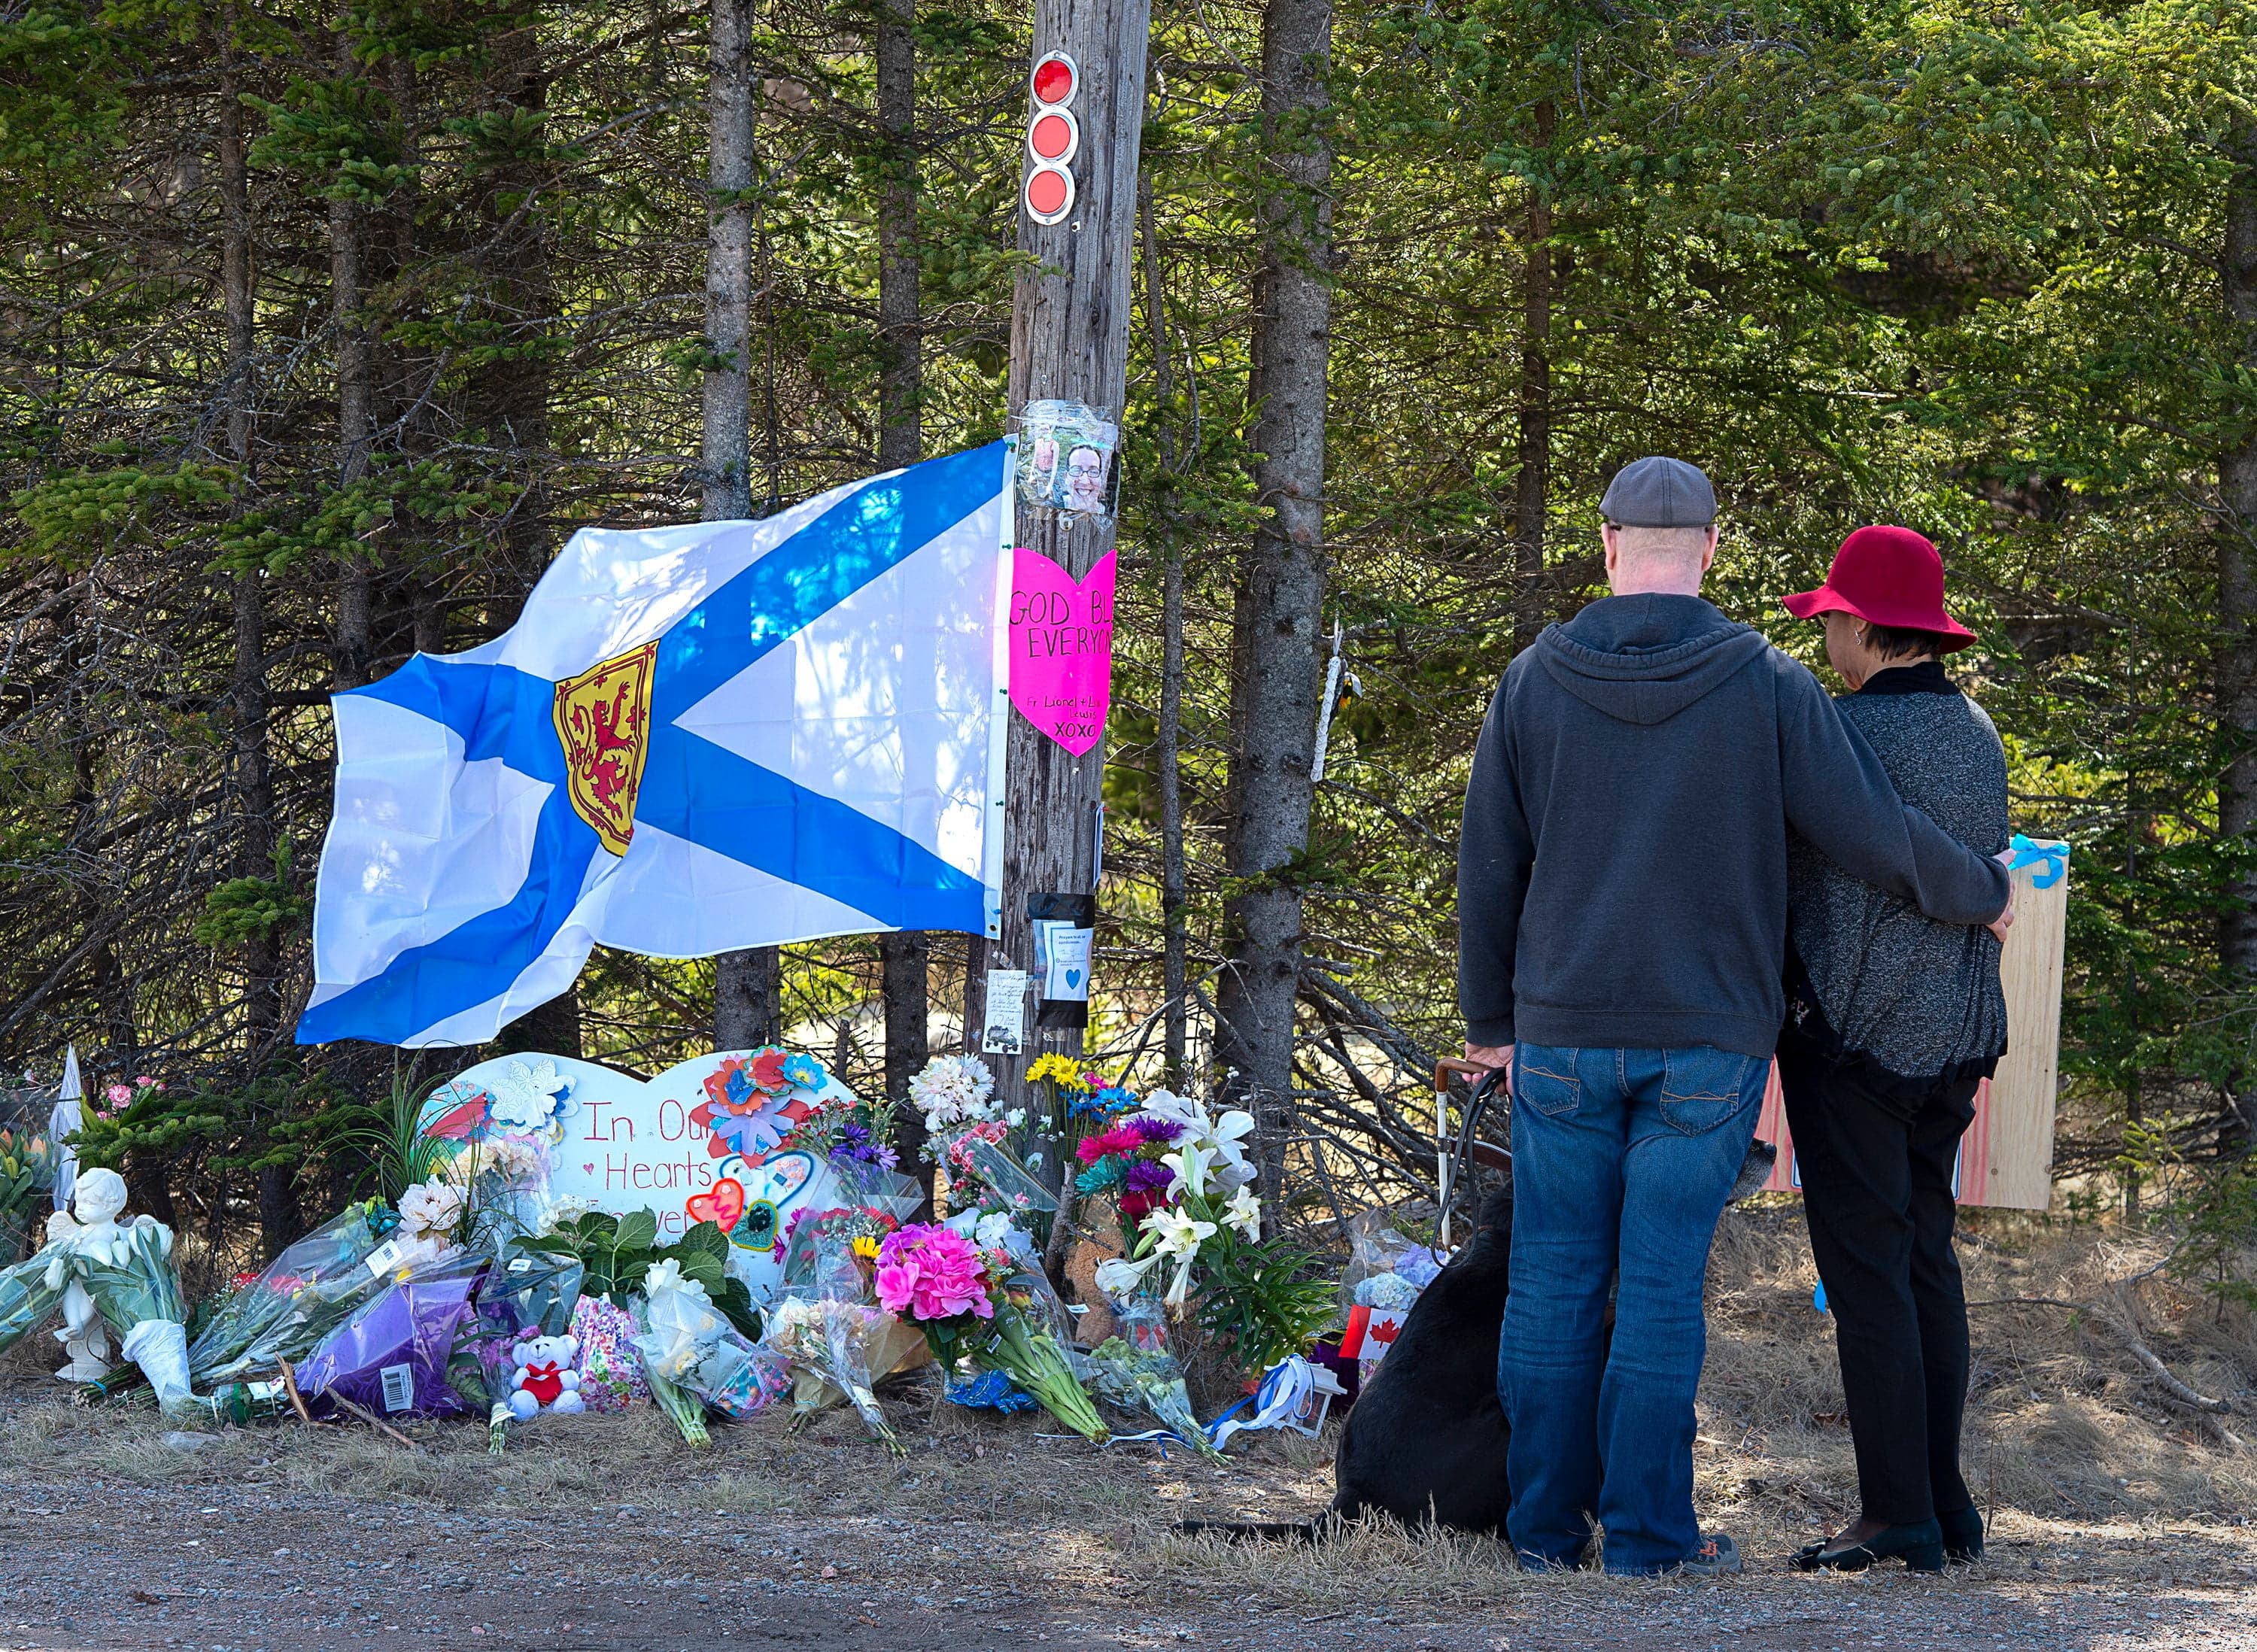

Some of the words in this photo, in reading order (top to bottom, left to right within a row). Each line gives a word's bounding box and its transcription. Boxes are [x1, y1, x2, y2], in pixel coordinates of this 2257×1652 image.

[1009, 591, 1070, 626] GOD
[582, 1101, 633, 1142] In
[606, 1150, 712, 1190] Hearts
